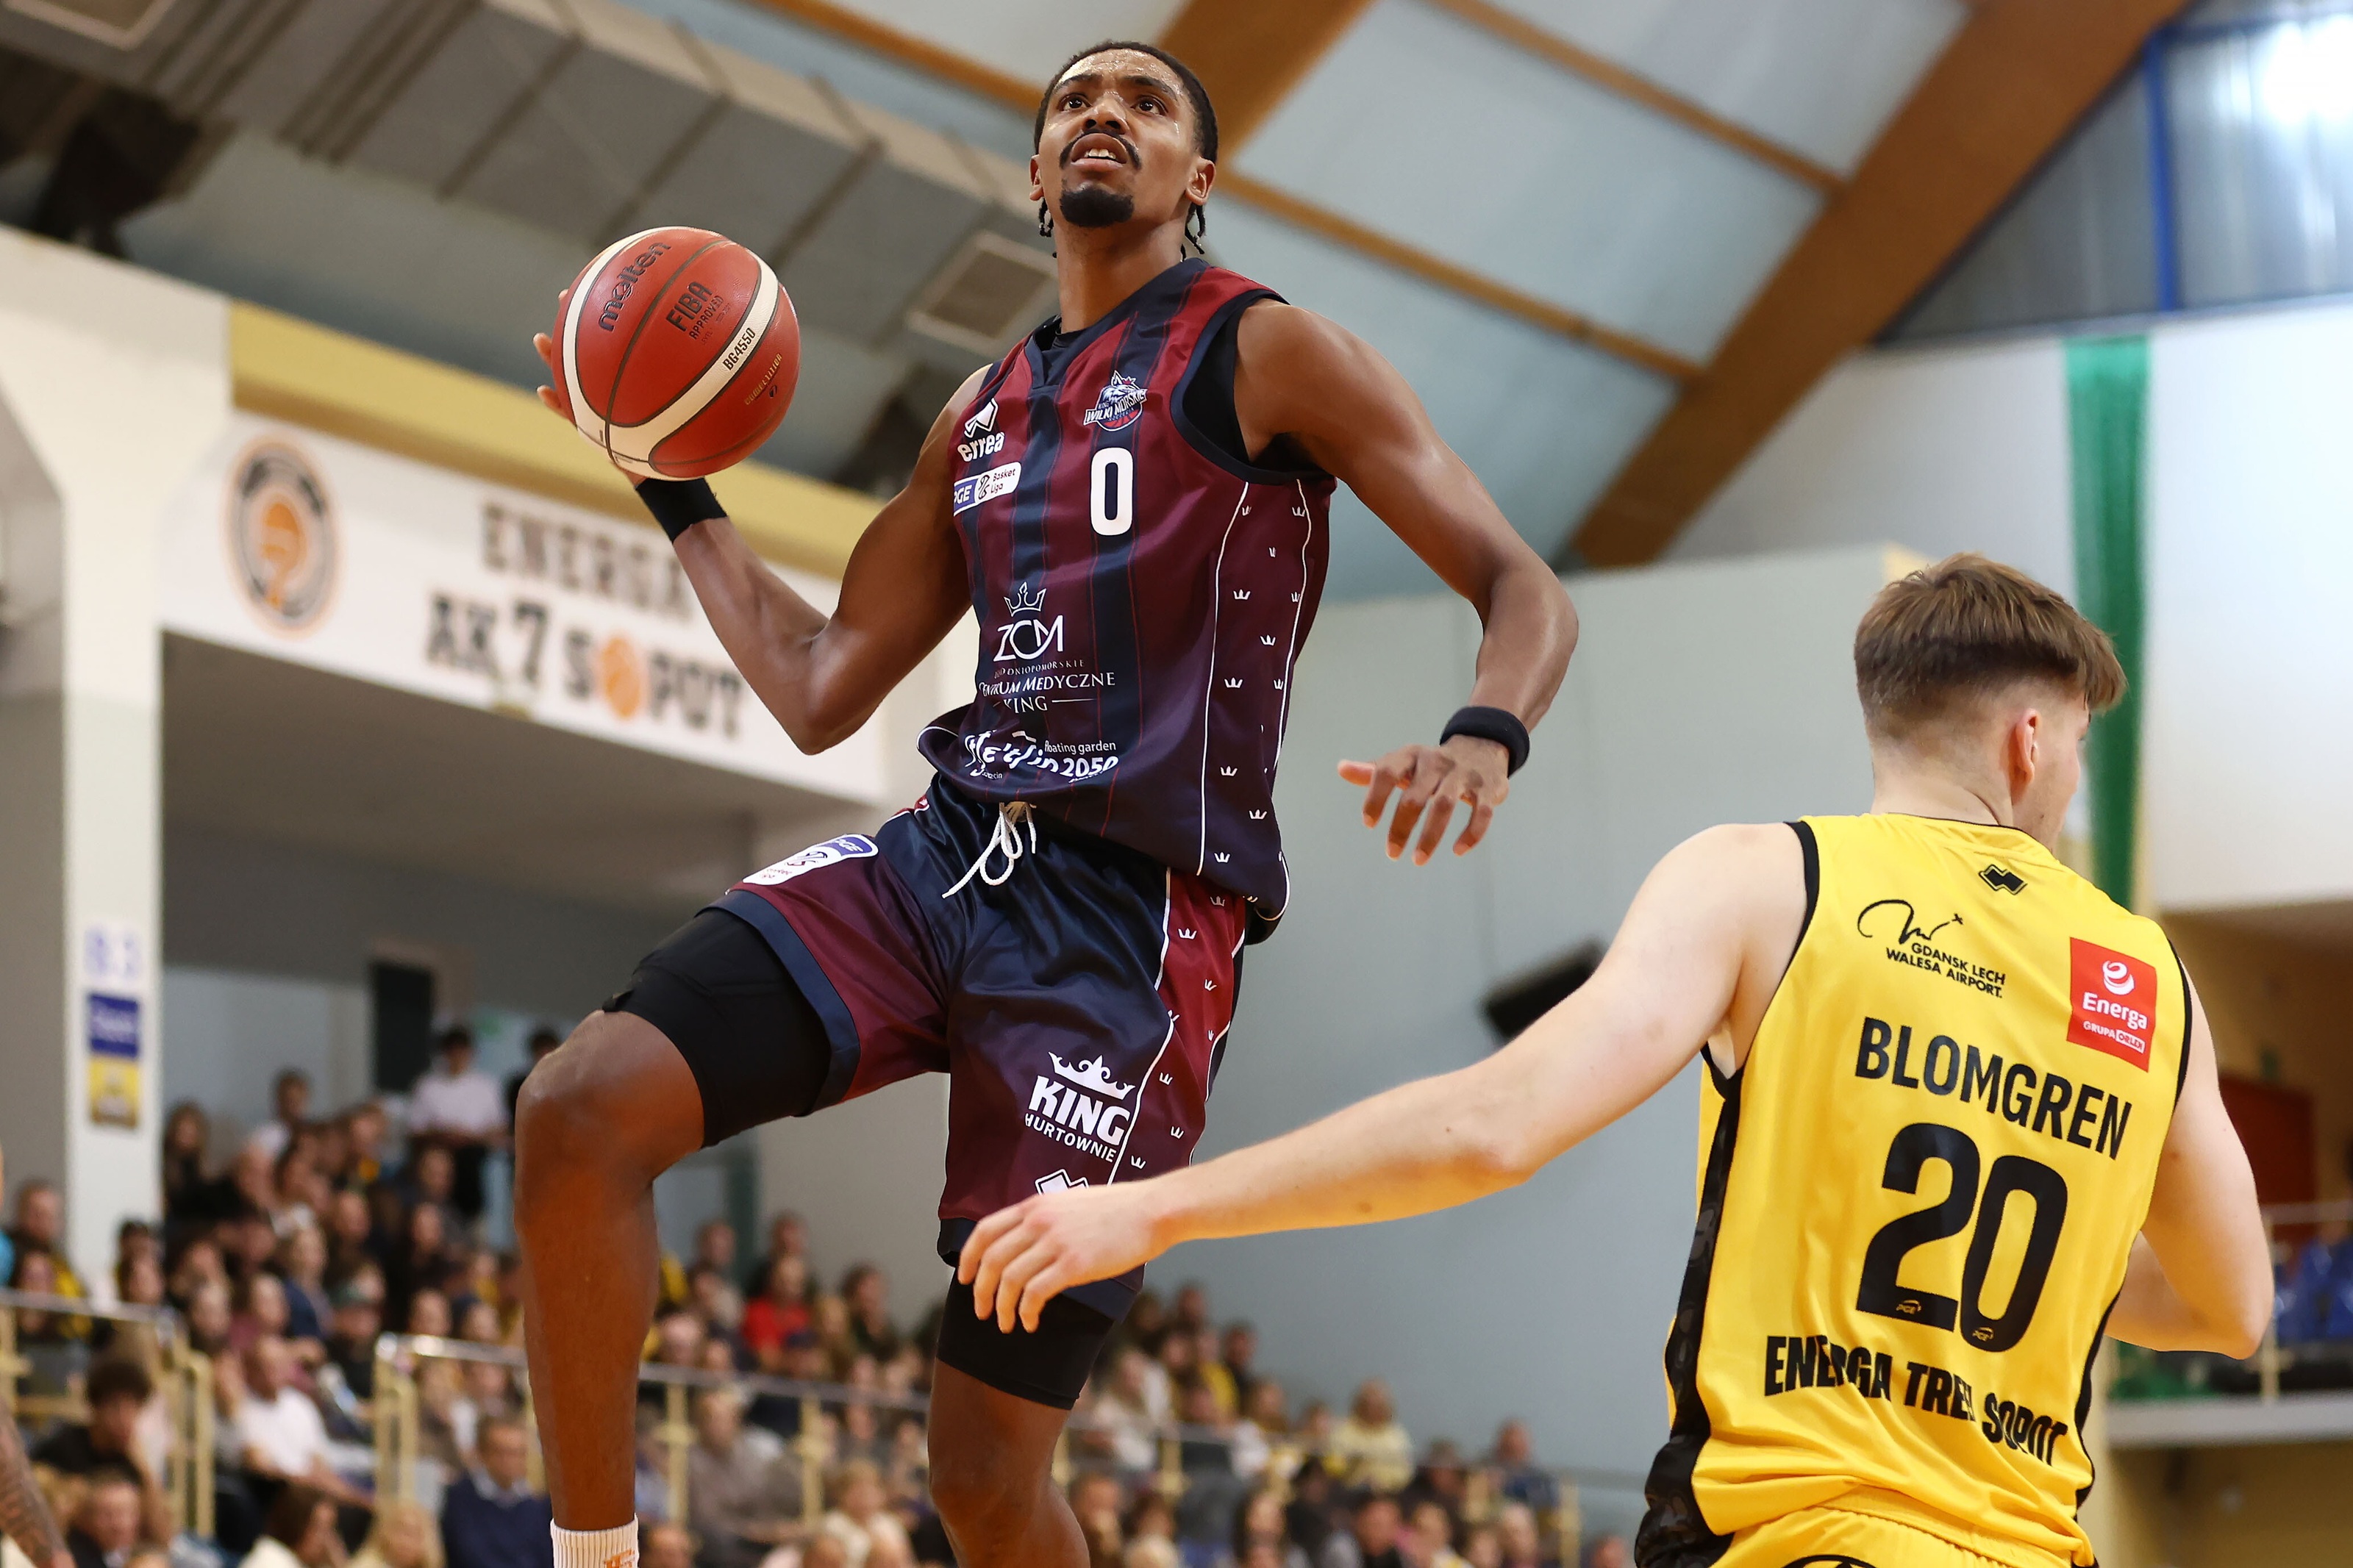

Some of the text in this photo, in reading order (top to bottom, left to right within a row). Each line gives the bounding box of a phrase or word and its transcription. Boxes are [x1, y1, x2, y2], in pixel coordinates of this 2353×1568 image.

[598, 242, 671, 332] molten
[665, 281, 713, 332] FIBA
[688, 295, 724, 340] APPROVED
[722, 327, 756, 370] BG4550
[1086, 406, 1113, 422] WILKI
[990, 483, 1004, 494] Liga
[993, 468, 1015, 482] Basket
[1090, 447, 1133, 536] 0
[993, 615, 1063, 662] ZCM
[1022, 671, 1115, 693] MEDYCZNE
[1044, 740, 1117, 756] floating garden
[1059, 755, 1119, 778] 2050
[1886, 946, 1942, 975] WALESA
[1911, 942, 2006, 986] GDANSK LECH
[2082, 991, 2148, 1031] Energa
[2082, 1020, 2117, 1040] GRUPA
[1028, 1075, 1131, 1146] KING
[1854, 1016, 2133, 1161] BLOMGREN
[1024, 1112, 1117, 1163] HURTOWNIE
[1855, 1122, 2068, 1353] 20
[1765, 1334, 1893, 1402] ENERGA
[1982, 1392, 2068, 1467] SOPOT
